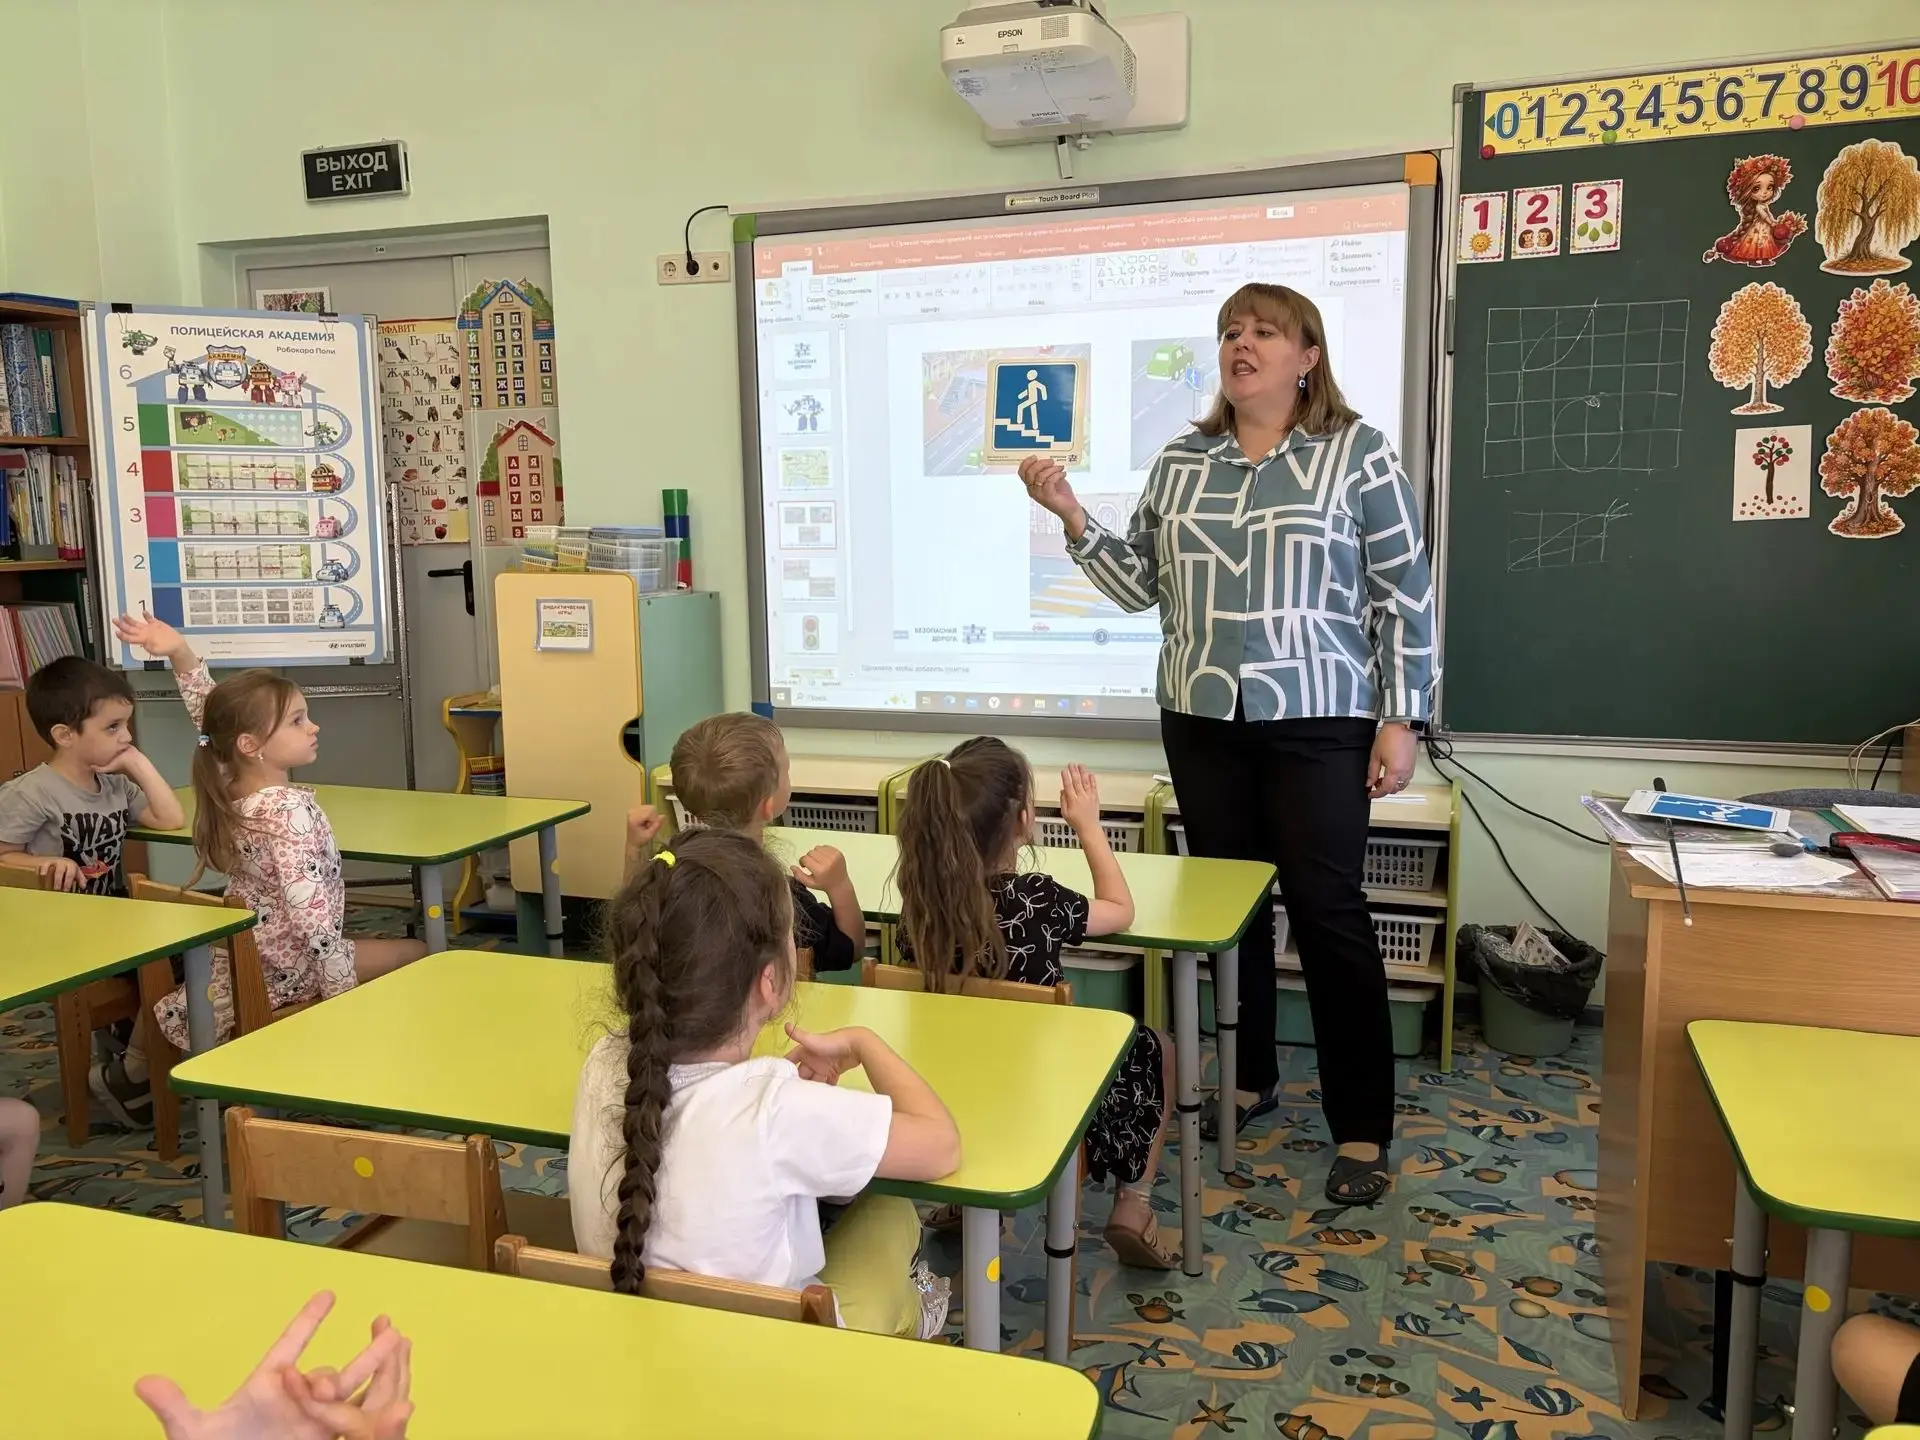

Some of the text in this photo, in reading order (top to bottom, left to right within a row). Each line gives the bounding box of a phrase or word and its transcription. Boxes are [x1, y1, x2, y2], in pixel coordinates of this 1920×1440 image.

[997, 28, 1023, 39] EPSON
[1871, 54, 1879, 62] +1
[1496, 58, 1920, 140] 0 1 2 3 4 5 6 7 8 9 10
[316, 151, 389, 173] ВЫХОД
[332, 172, 374, 192] EXIT
[1039, 195, 1059, 203] Touch
[1060, 193, 1081, 201] Board
[1584, 188, 1609, 219] 3
[1474, 200, 1490, 231] 1
[1526, 194, 1550, 225] 2
[170, 326, 335, 342] ПОЛИЦЕЙСКАЯ АКАДЕМИЯ
[378, 324, 416, 335] ЛФАВИТ
[384, 337, 398, 348] Вв
[410, 336, 421, 346] Гг
[277, 346, 336, 355] Робокара Поли
[119, 364, 133, 380] 6
[413, 366, 425, 376] Зз
[414, 396, 431, 406] Мм
[123, 416, 135, 431] 5
[391, 425, 458, 440] Рр Сс Тт
[394, 457, 408, 468] Хх
[446, 455, 459, 465] Чч
[126, 462, 140, 477] 4
[130, 508, 142, 523] 3
[424, 516, 437, 525] Яя
[134, 555, 146, 570] 2
